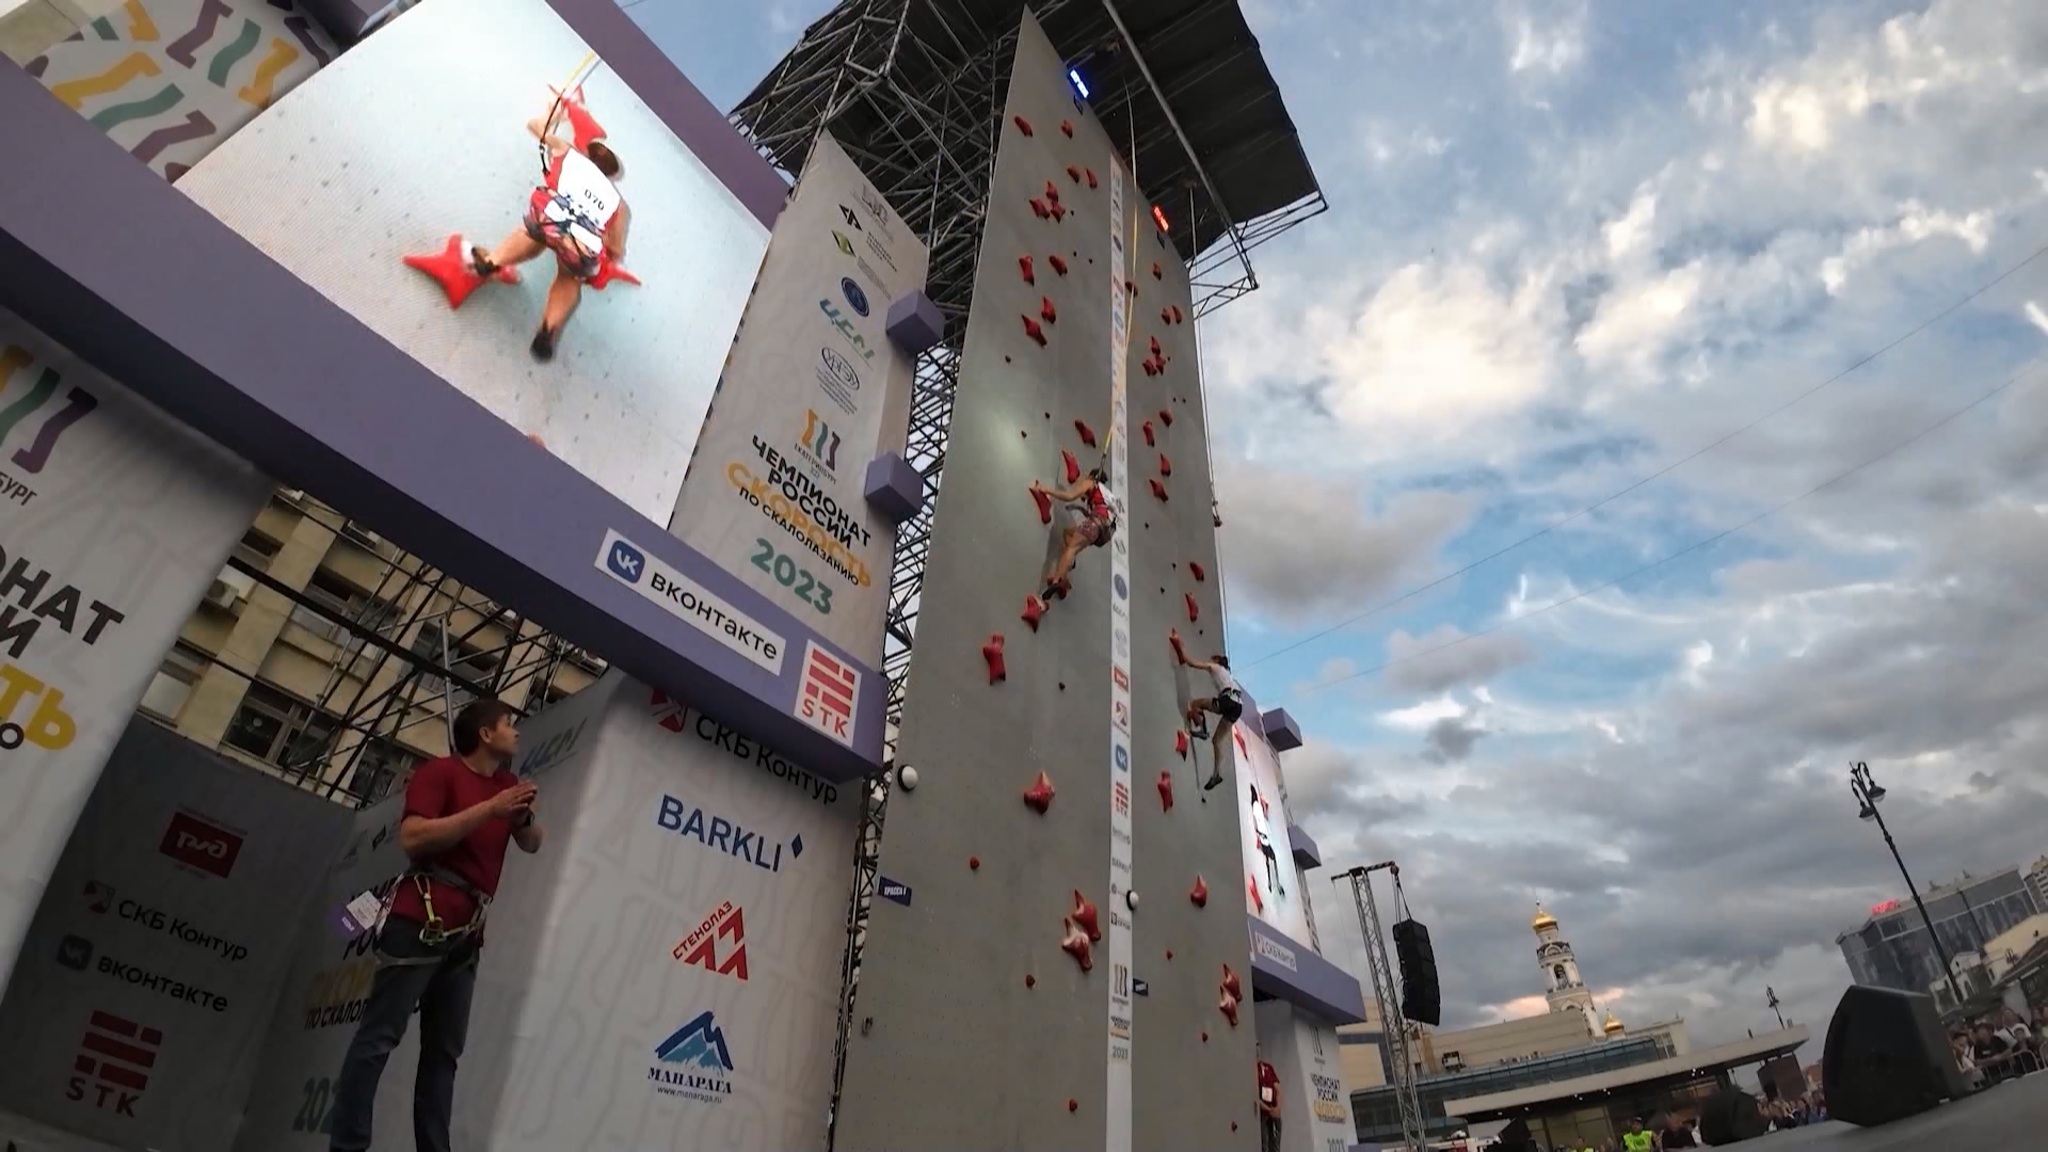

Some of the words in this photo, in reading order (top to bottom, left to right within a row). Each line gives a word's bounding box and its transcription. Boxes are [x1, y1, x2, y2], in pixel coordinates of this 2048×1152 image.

[752, 434, 871, 548] ЧЕМПИОНАТ
[767, 469, 852, 550] РОССИИ
[738, 486, 760, 507] ПО
[762, 503, 859, 587] СКАЛОЛАЗАНИЮ
[750, 537, 834, 615] 2023
[0, 544, 125, 646] НАТ
[650, 571, 778, 660] вконтакте
[801, 699, 849, 739] STK
[695, 714, 751, 760] СКБ
[755, 744, 838, 805] Контур
[657, 793, 783, 873] BARKLI
[118, 898, 167, 931] СКБ
[169, 917, 248, 962] Контур
[672, 900, 734, 961] СТЕНОЛАЗ
[66, 1076, 140, 1119] STK
[647, 1066, 733, 1095] МАНАРАГА
